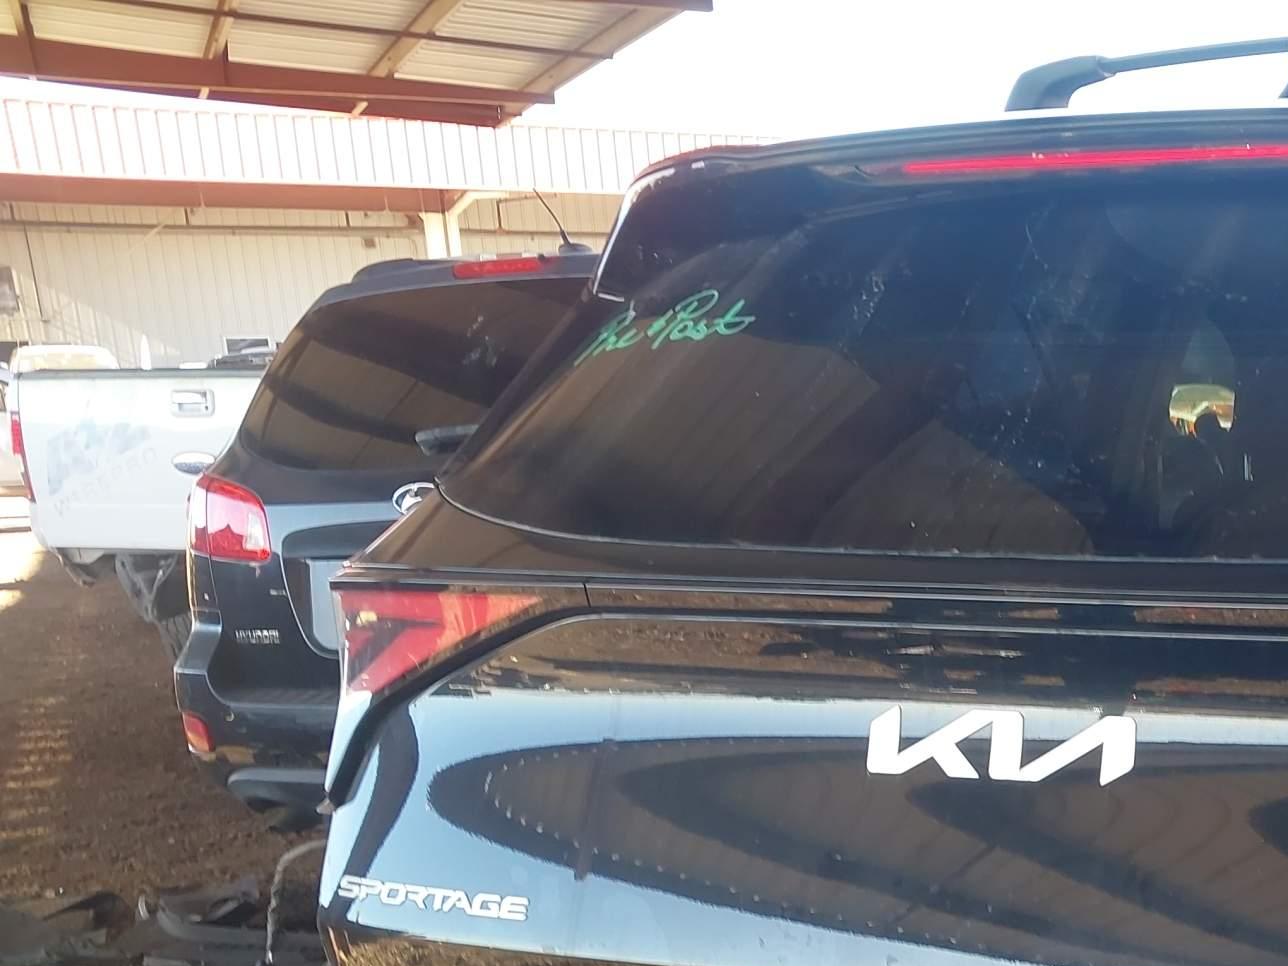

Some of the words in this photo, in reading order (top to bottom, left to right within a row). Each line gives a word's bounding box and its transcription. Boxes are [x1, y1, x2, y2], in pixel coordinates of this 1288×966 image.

[235, 629, 280, 644] HYUNDAI
[866, 704, 1137, 787] KIA
[338, 874, 529, 921] SPORTAGE
